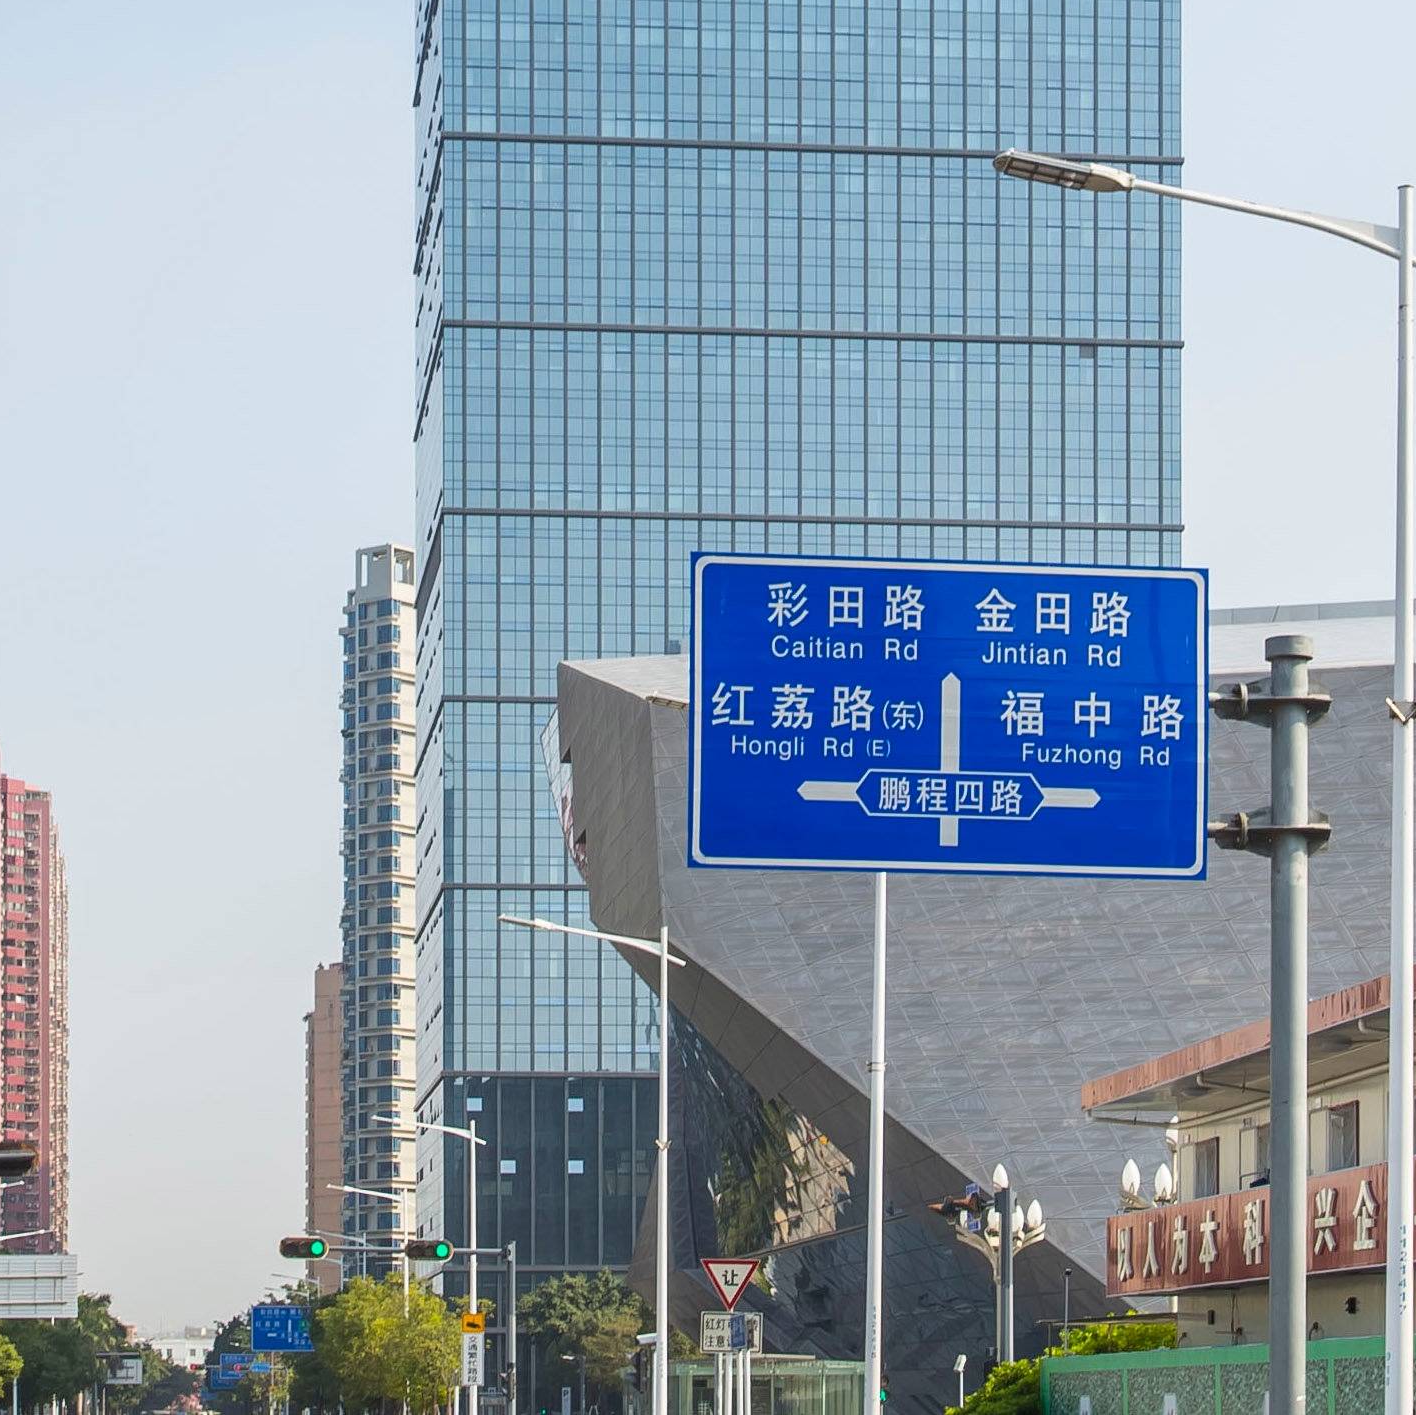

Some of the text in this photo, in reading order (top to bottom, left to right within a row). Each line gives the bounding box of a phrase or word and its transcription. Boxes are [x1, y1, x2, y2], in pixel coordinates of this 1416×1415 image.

[766, 581, 926, 631] 彩田路
[975, 587, 1132, 639] 金田路
[771, 635, 918, 661] Caitian Rd
[981, 641, 1121, 668] Jintian Rd
[1000, 689, 1184, 741] 福中路
[731, 735, 891, 761] Hongli Rd (E)
[1021, 742, 1171, 770] Fuzhong Rd
[878, 774, 1024, 817] 鹏程四路
[1242, 1179, 1378, 1266] 科兴企
[721, 1268, 739, 1287] 让
